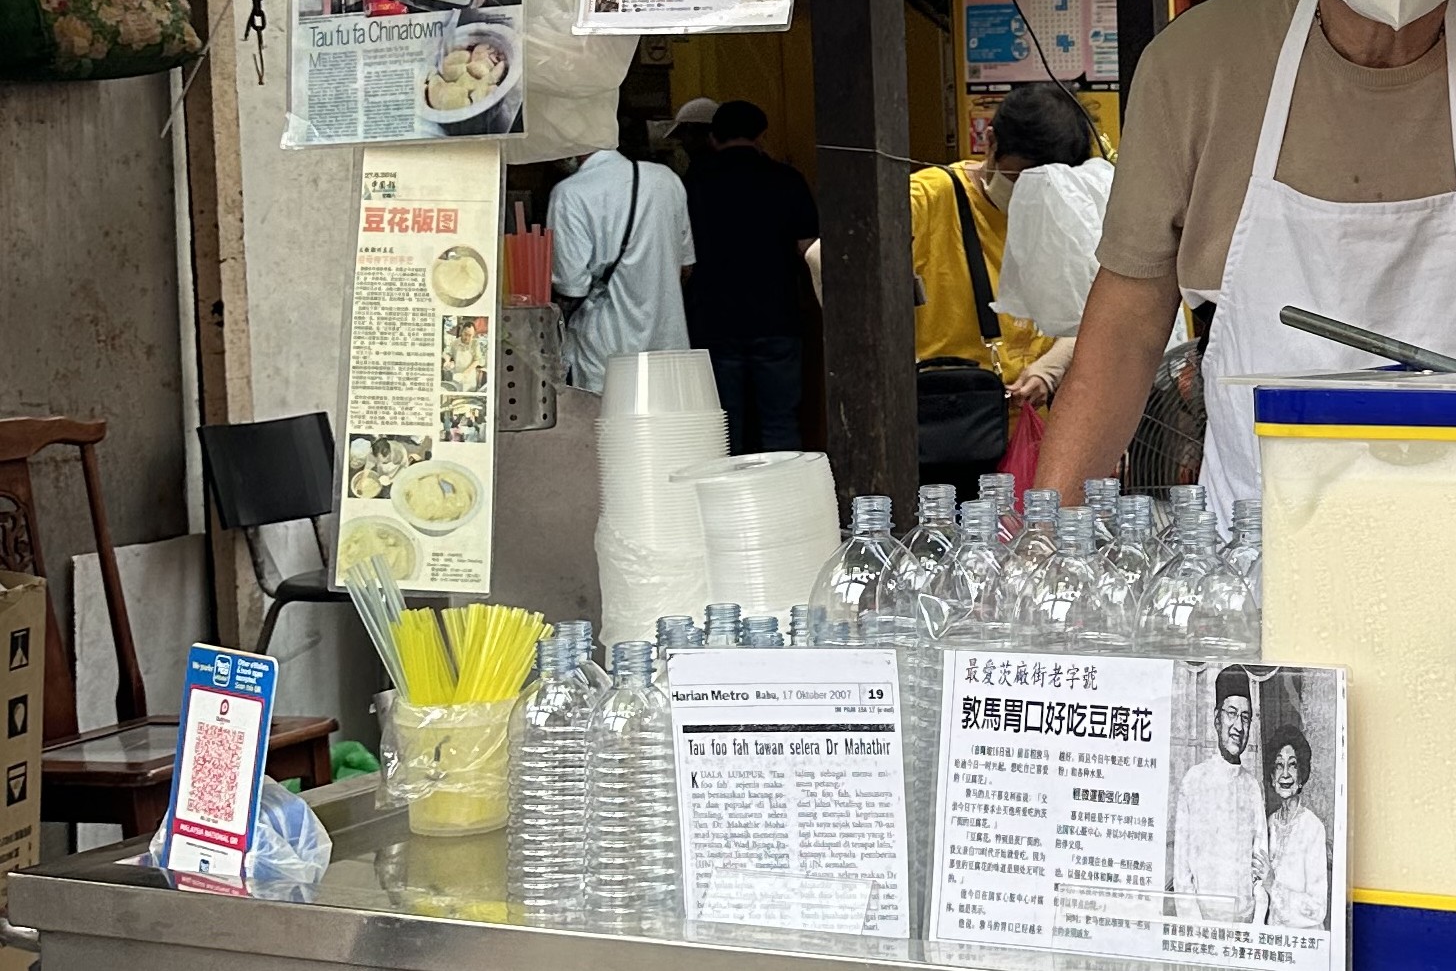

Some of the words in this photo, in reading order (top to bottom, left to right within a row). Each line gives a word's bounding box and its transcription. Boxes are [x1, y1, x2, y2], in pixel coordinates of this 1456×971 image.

[309, 27, 332, 47] Tau
[336, 26, 349, 45] fu
[353, 24, 365, 44] fa
[368, 20, 444, 42] Chinatown
[363, 207, 459, 234] 豆花版图
[672, 690, 709, 701] Harian
[711, 690, 750, 701] Metro
[783, 691, 793, 700] 17
[796, 690, 827, 700] Oktober
[829, 690, 852, 700] 2007
[868, 689, 884, 700] 19
[961, 695, 1152, 742] 敦馬胃口好吃豆腐花
[688, 740, 705, 756] Tau
[711, 739, 727, 755] foo
[733, 739, 749, 755] fah
[755, 740, 784, 755] tawan
[790, 739, 820, 755] selera
[826, 739, 839, 755] Dr
[844, 738, 891, 755] Mahathir
